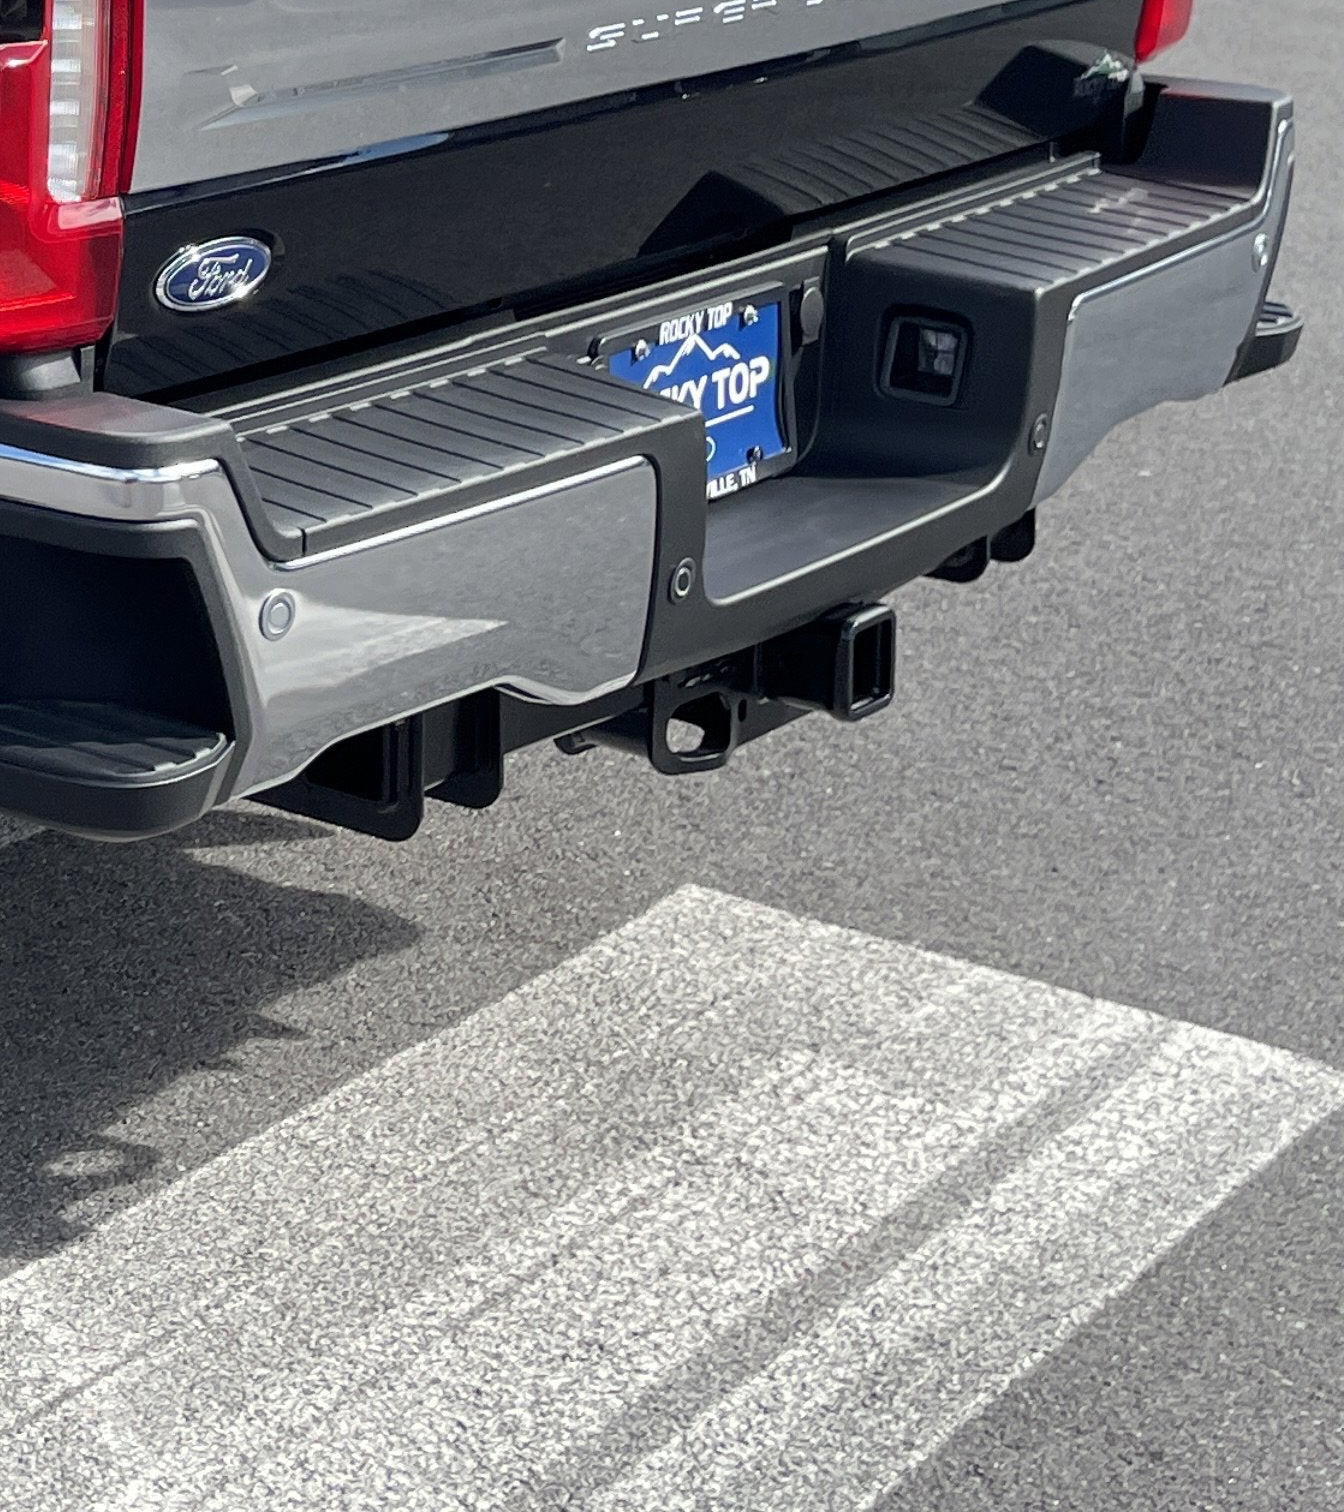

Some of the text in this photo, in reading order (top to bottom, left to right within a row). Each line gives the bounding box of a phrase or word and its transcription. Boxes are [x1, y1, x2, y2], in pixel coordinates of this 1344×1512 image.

[188, 253, 253, 301] Ford
[659, 302, 733, 346] ROCKY TOP
[712, 355, 770, 410] TOP
[739, 461, 757, 487] TN
